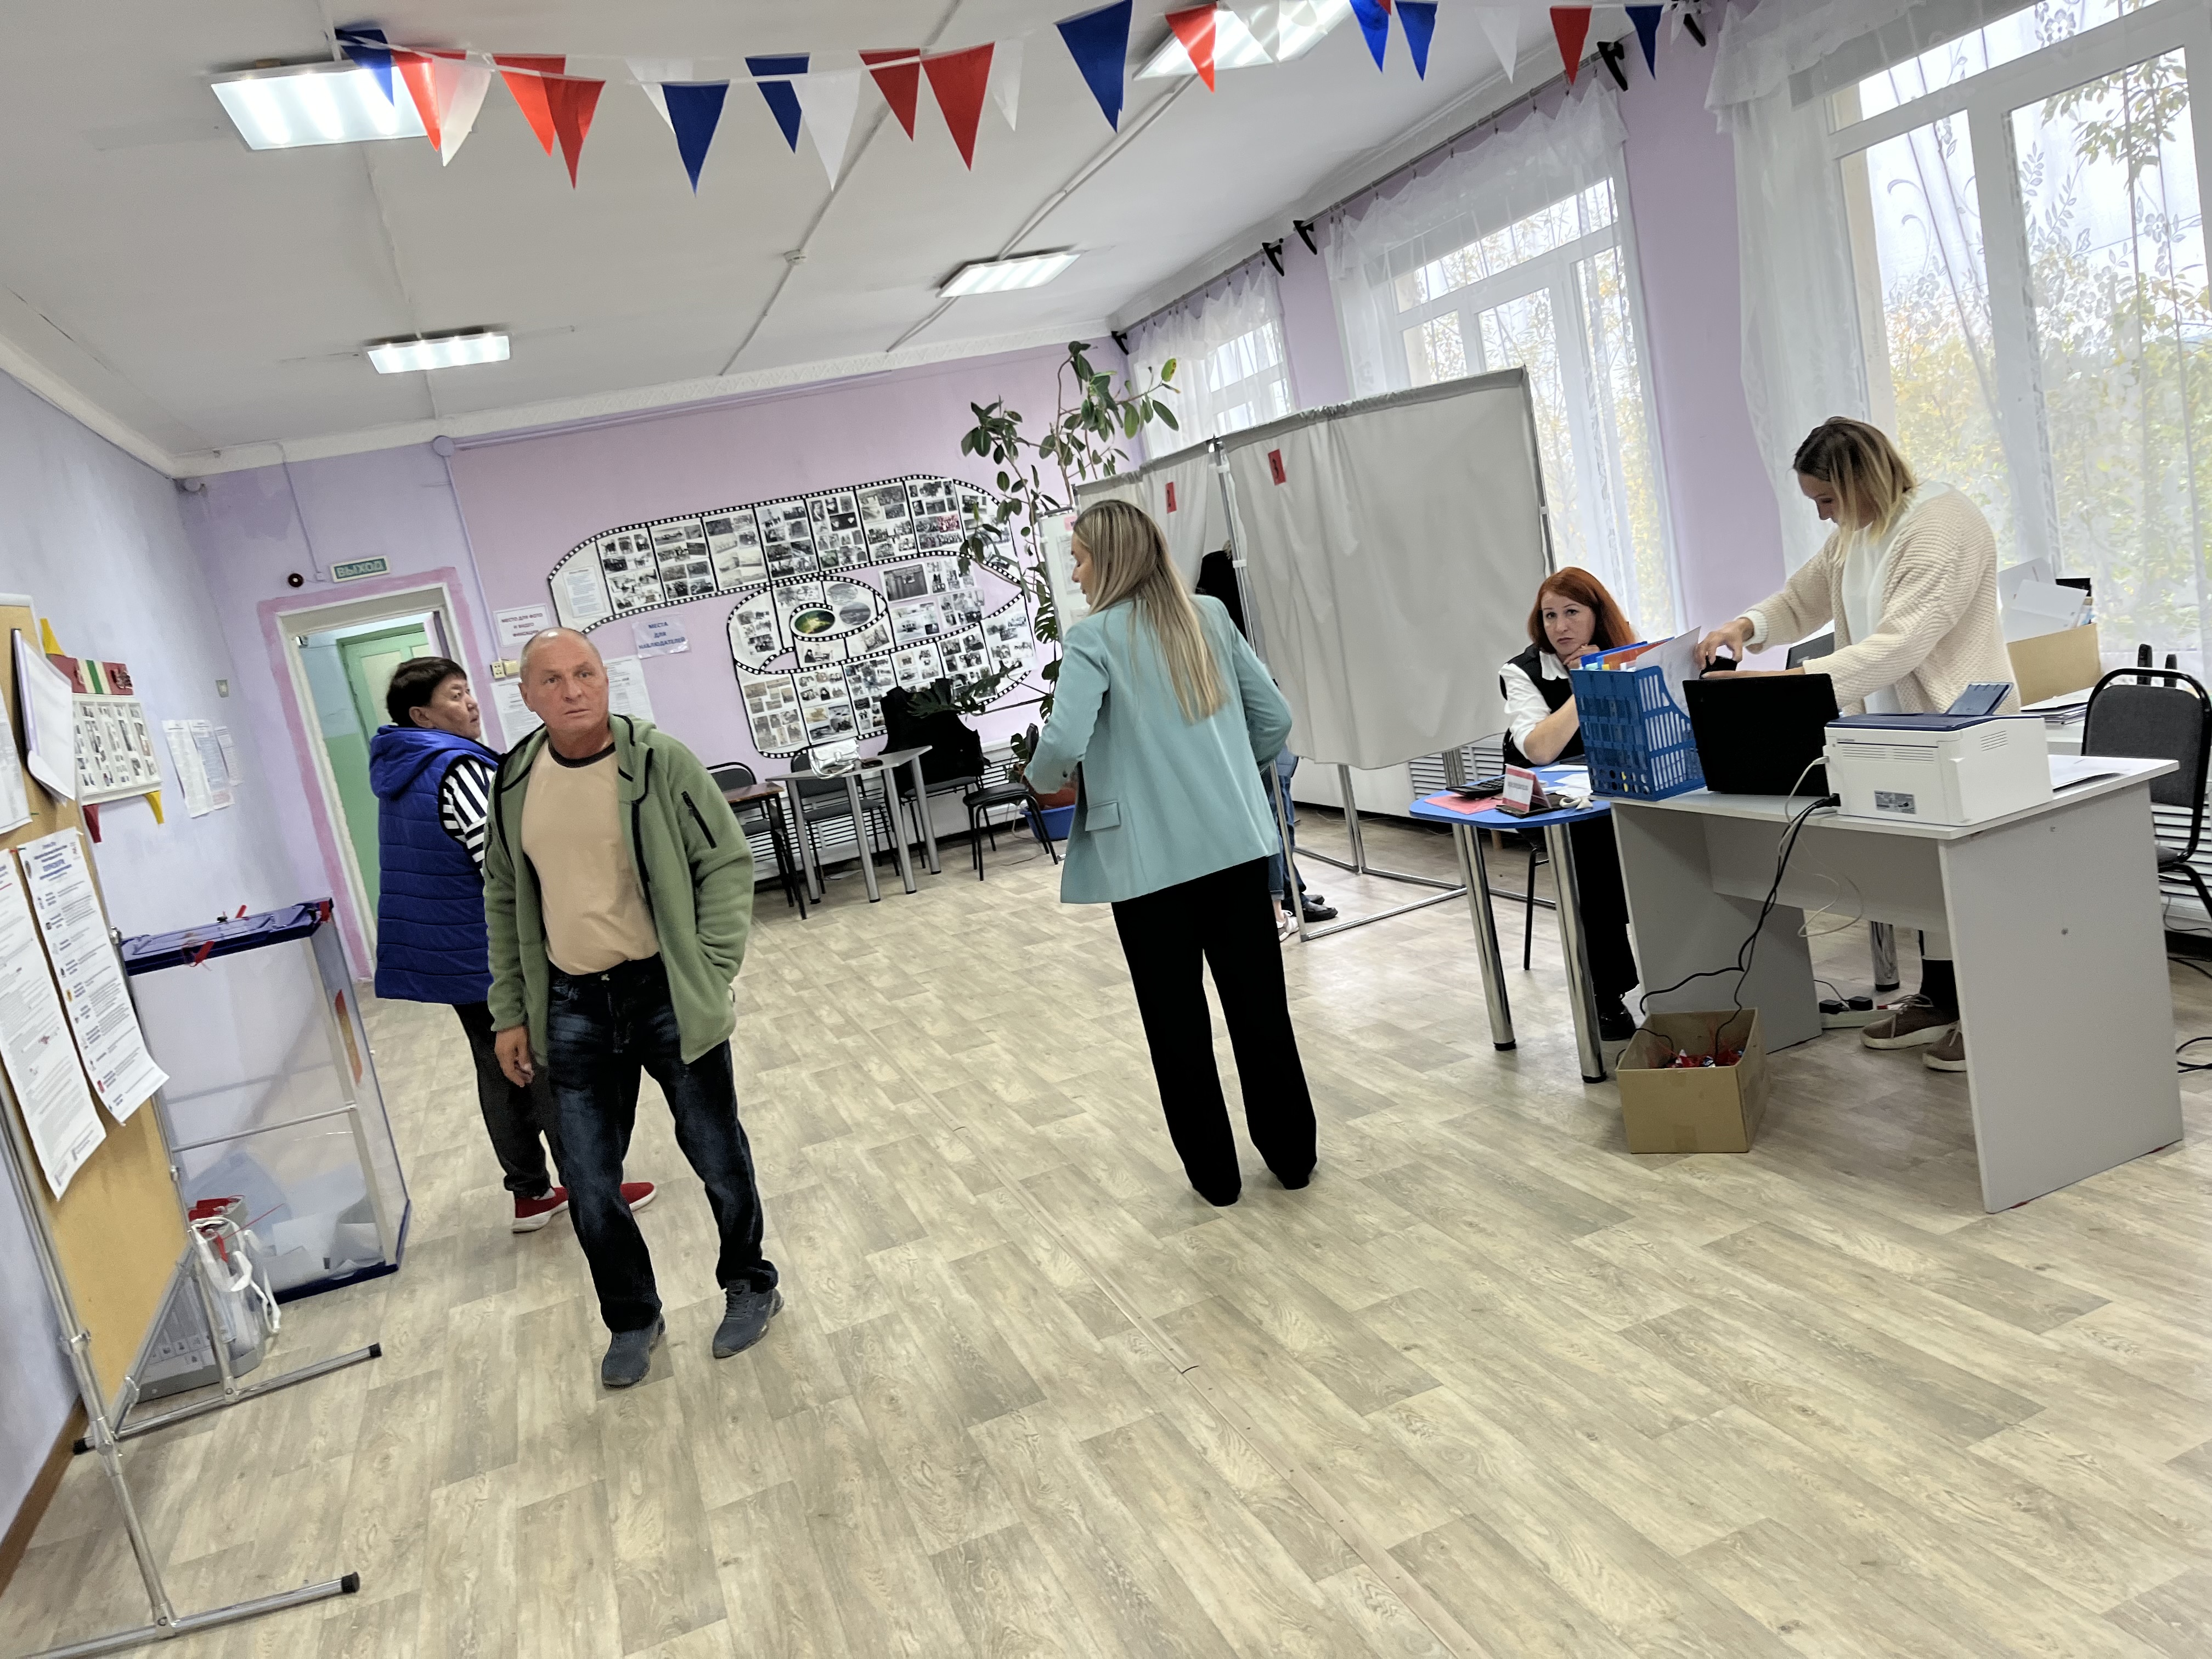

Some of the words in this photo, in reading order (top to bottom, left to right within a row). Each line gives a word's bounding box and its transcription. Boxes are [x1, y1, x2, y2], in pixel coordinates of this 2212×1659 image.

[1272, 458, 1279, 479] 3
[336, 560, 385, 577] ВЫХОД
[638, 636, 686, 650] НАБЛЮДАТЕЛЕЙ
